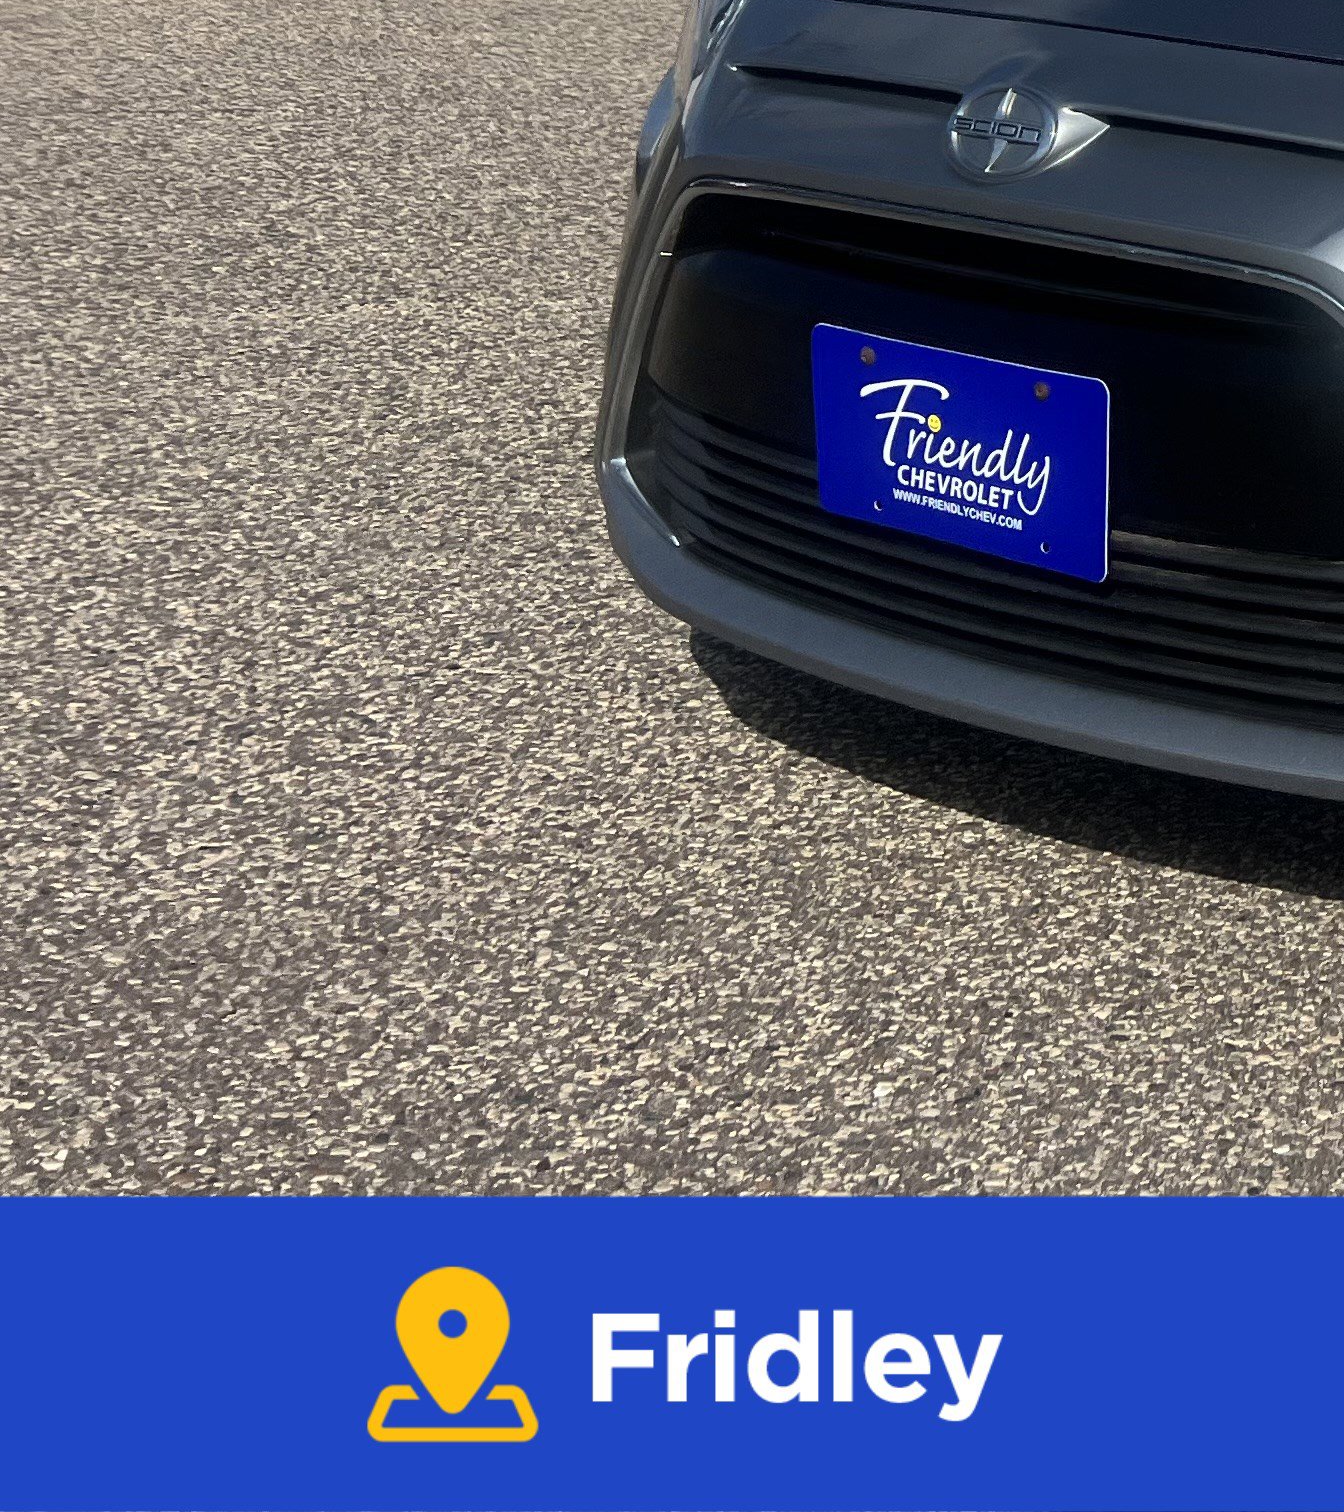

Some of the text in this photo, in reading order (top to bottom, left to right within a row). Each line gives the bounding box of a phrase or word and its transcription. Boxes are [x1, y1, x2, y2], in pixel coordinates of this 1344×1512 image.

[952, 114, 1042, 144] SCION
[859, 378, 1050, 515] Friendly
[892, 487, 1023, 531] WWW.FRIENDLYCHEV.COM
[897, 464, 1014, 510] CHEVROLET
